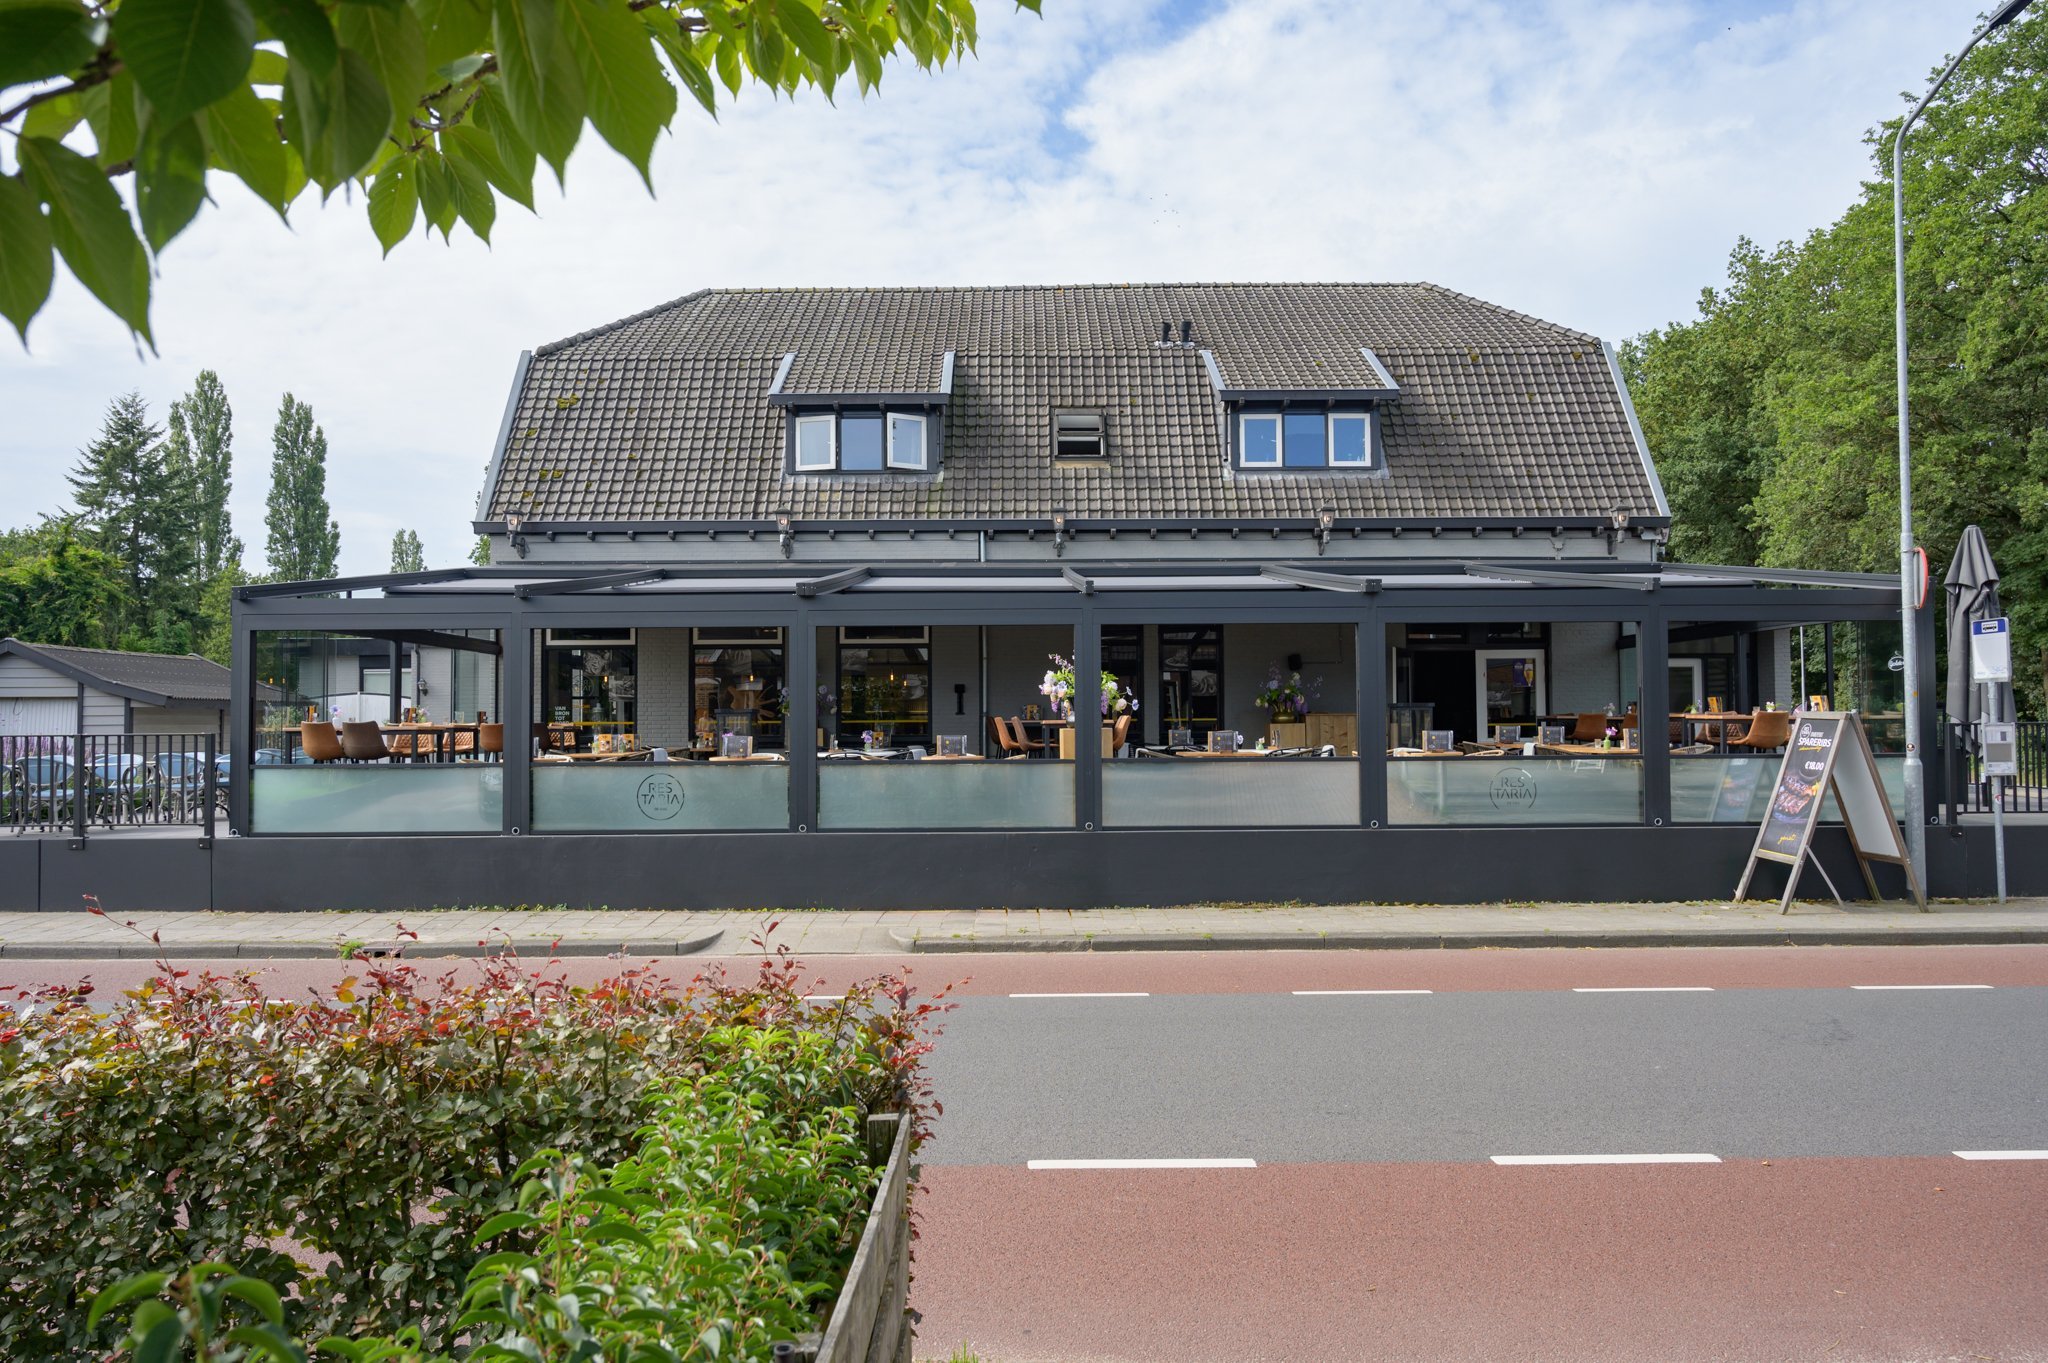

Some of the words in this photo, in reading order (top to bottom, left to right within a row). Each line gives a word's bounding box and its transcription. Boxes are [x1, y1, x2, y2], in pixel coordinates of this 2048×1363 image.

[1798, 737, 1832, 747] SPARERIBS
[648, 783, 673, 793] RES
[1494, 788, 1532, 799] TARIA
